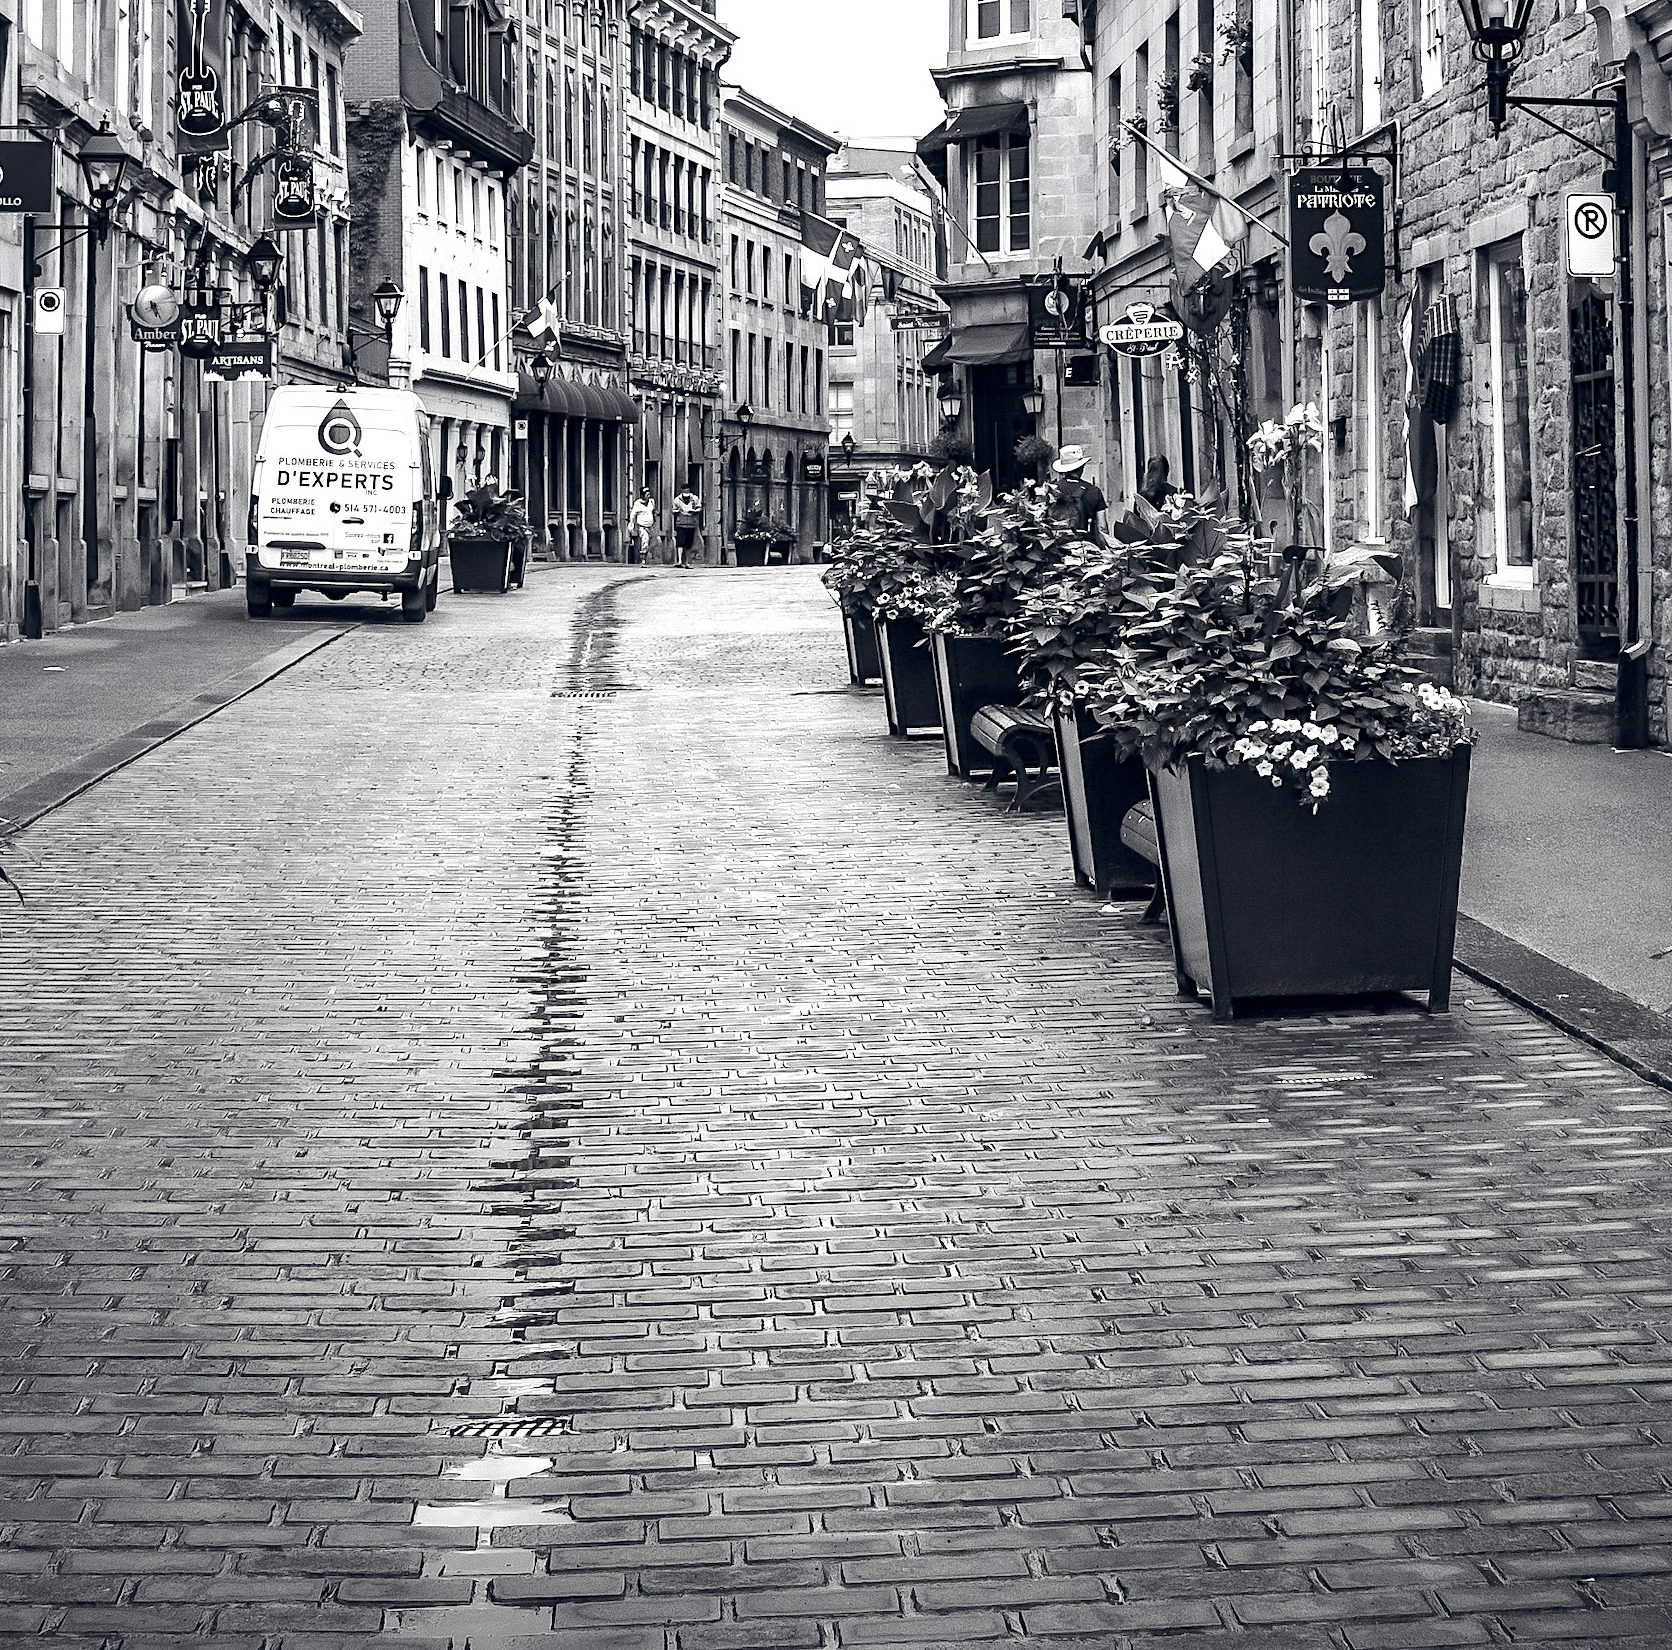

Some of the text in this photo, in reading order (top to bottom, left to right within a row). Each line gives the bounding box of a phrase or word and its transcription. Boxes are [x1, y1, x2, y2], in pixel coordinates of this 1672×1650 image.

[1310, 175, 1363, 184] BOUTE
[134, 327, 177, 340] Amber
[196, 319, 221, 346] PAUL
[211, 356, 264, 367] ARTISANS
[278, 457, 334, 467] PLOMBERIE
[347, 460, 396, 470] SERVICES
[277, 470, 394, 491] D'EXPERTS
[271, 497, 316, 506] PLOMBERIE
[270, 507, 316, 516] CHAUFFAGE
[344, 503, 406, 514] 514 571-4003
